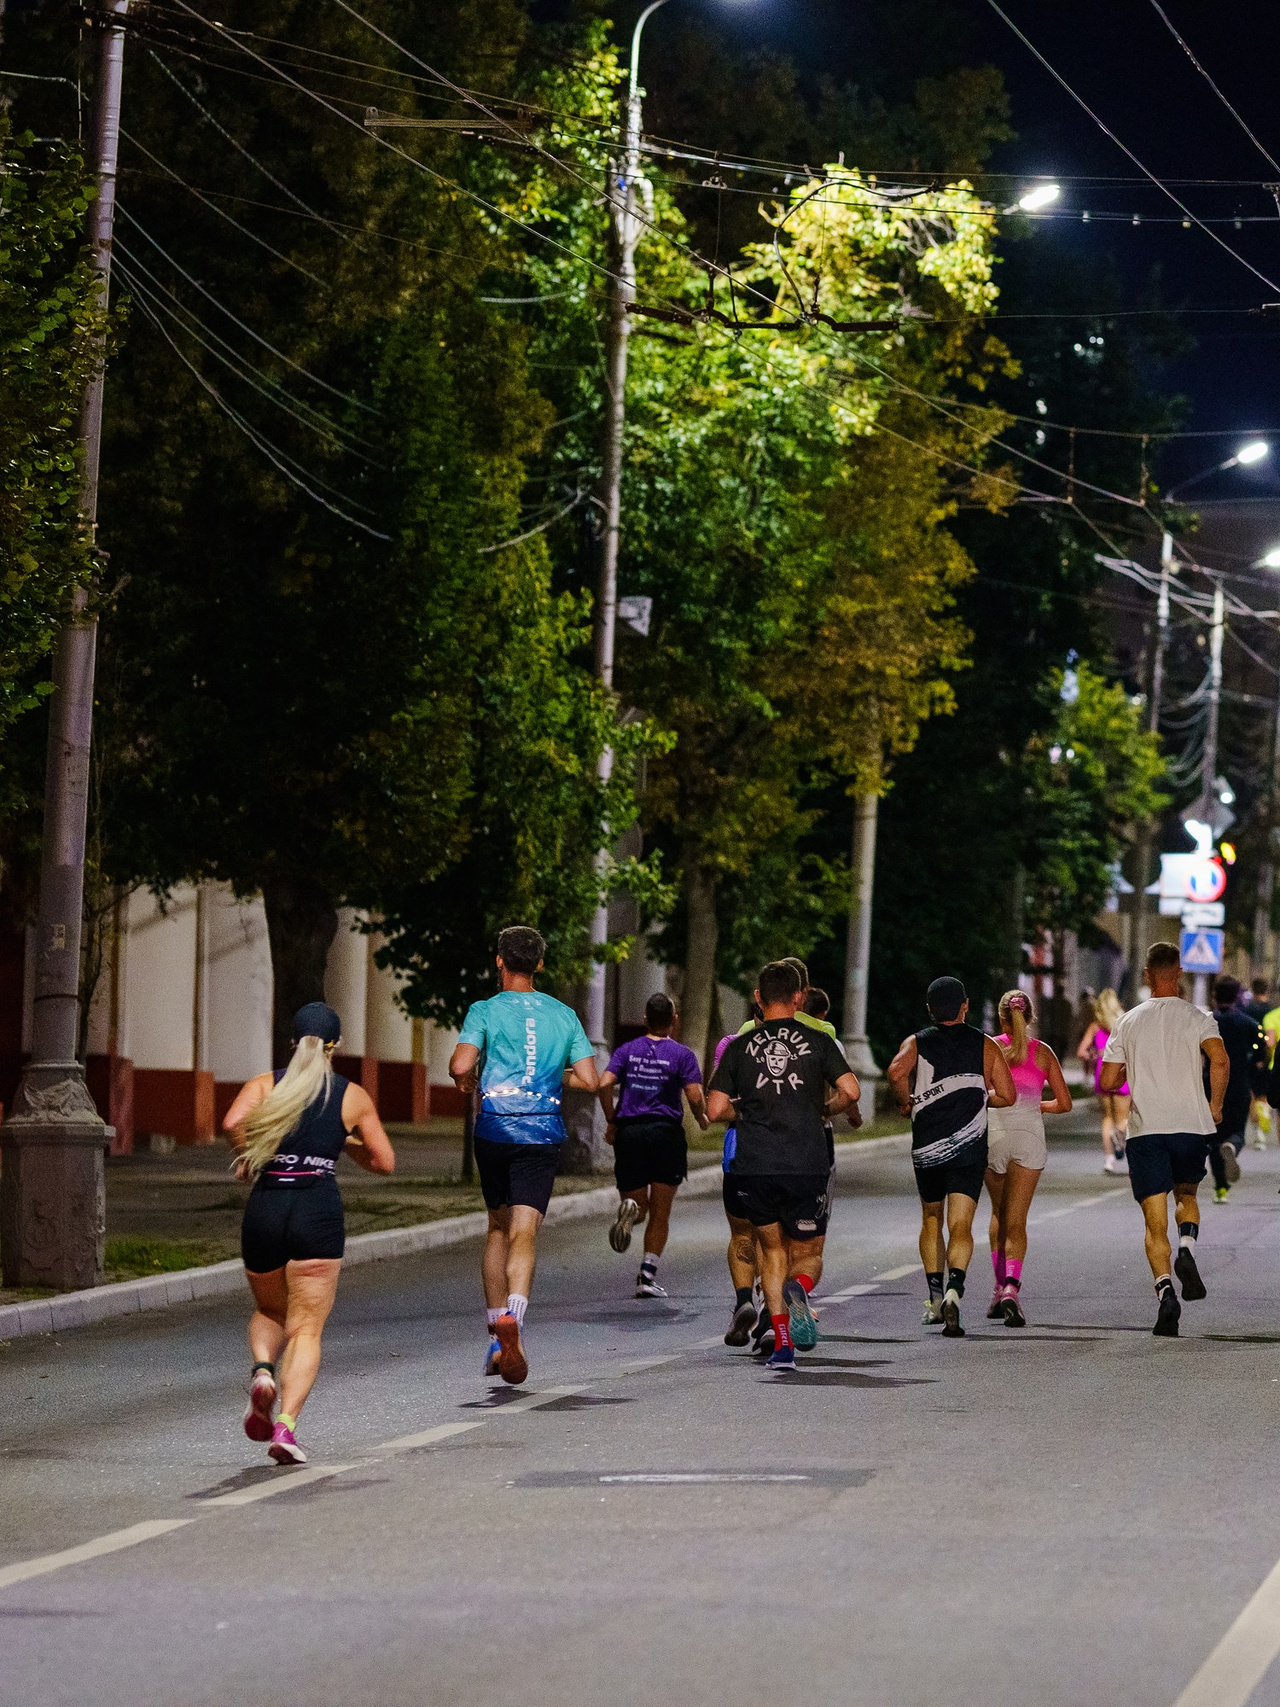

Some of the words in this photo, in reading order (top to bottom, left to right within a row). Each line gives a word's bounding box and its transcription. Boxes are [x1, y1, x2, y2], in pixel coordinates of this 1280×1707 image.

[521, 1017, 537, 1085] Pandora
[745, 1027, 812, 1057] ZELRUN
[755, 1072, 804, 1095] VTR
[923, 1084, 945, 1099] SPORT
[303, 1156, 334, 1169] NIKE
